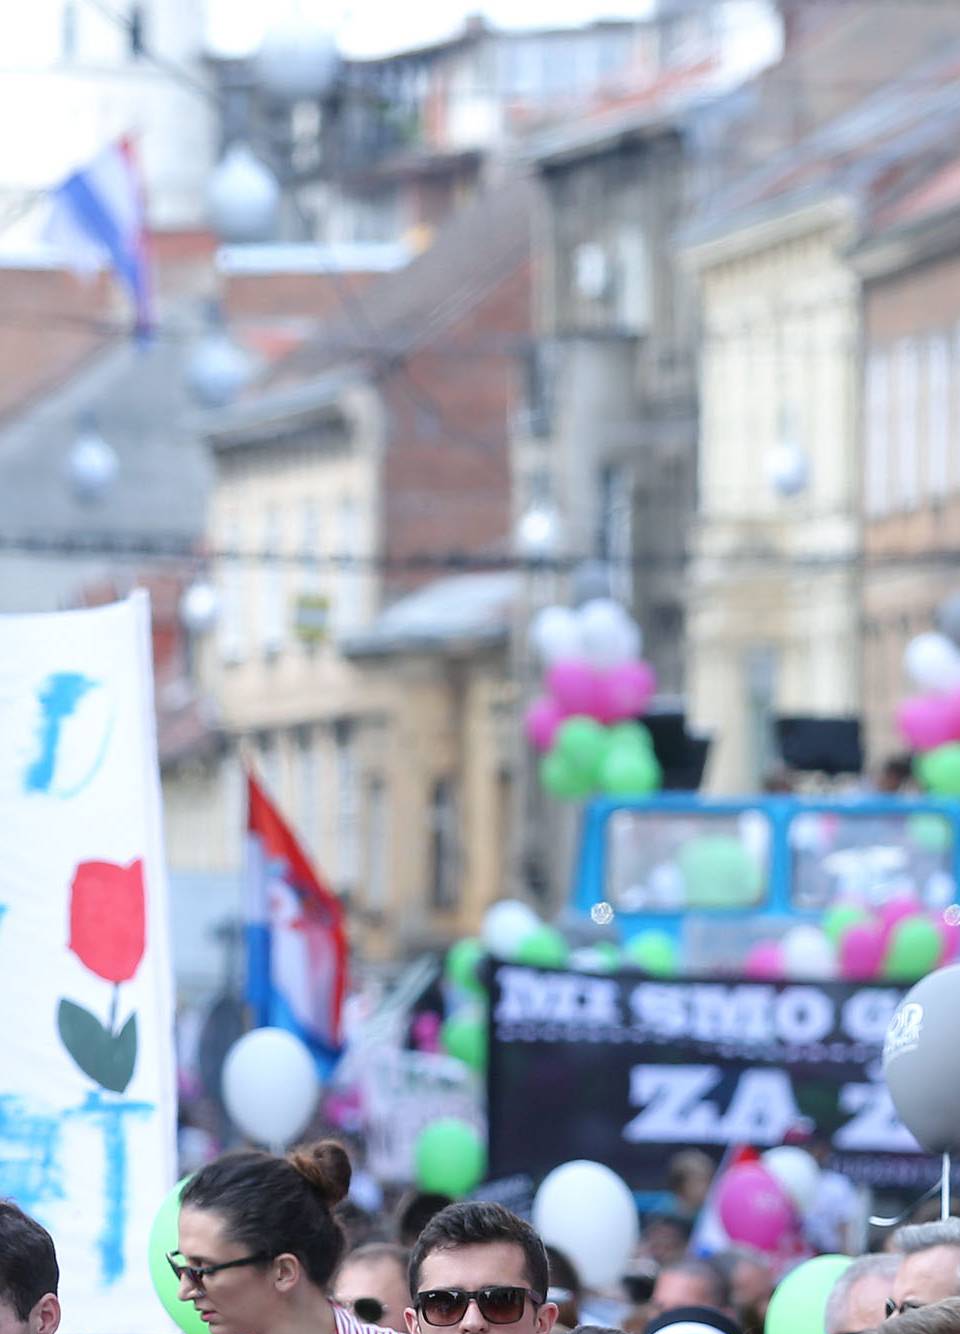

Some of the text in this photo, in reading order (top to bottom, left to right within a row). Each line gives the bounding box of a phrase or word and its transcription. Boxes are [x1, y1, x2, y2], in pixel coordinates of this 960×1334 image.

[496, 968, 621, 1026] MI
[631, 982, 834, 1044] SMO
[622, 1064, 816, 1146] ZA
